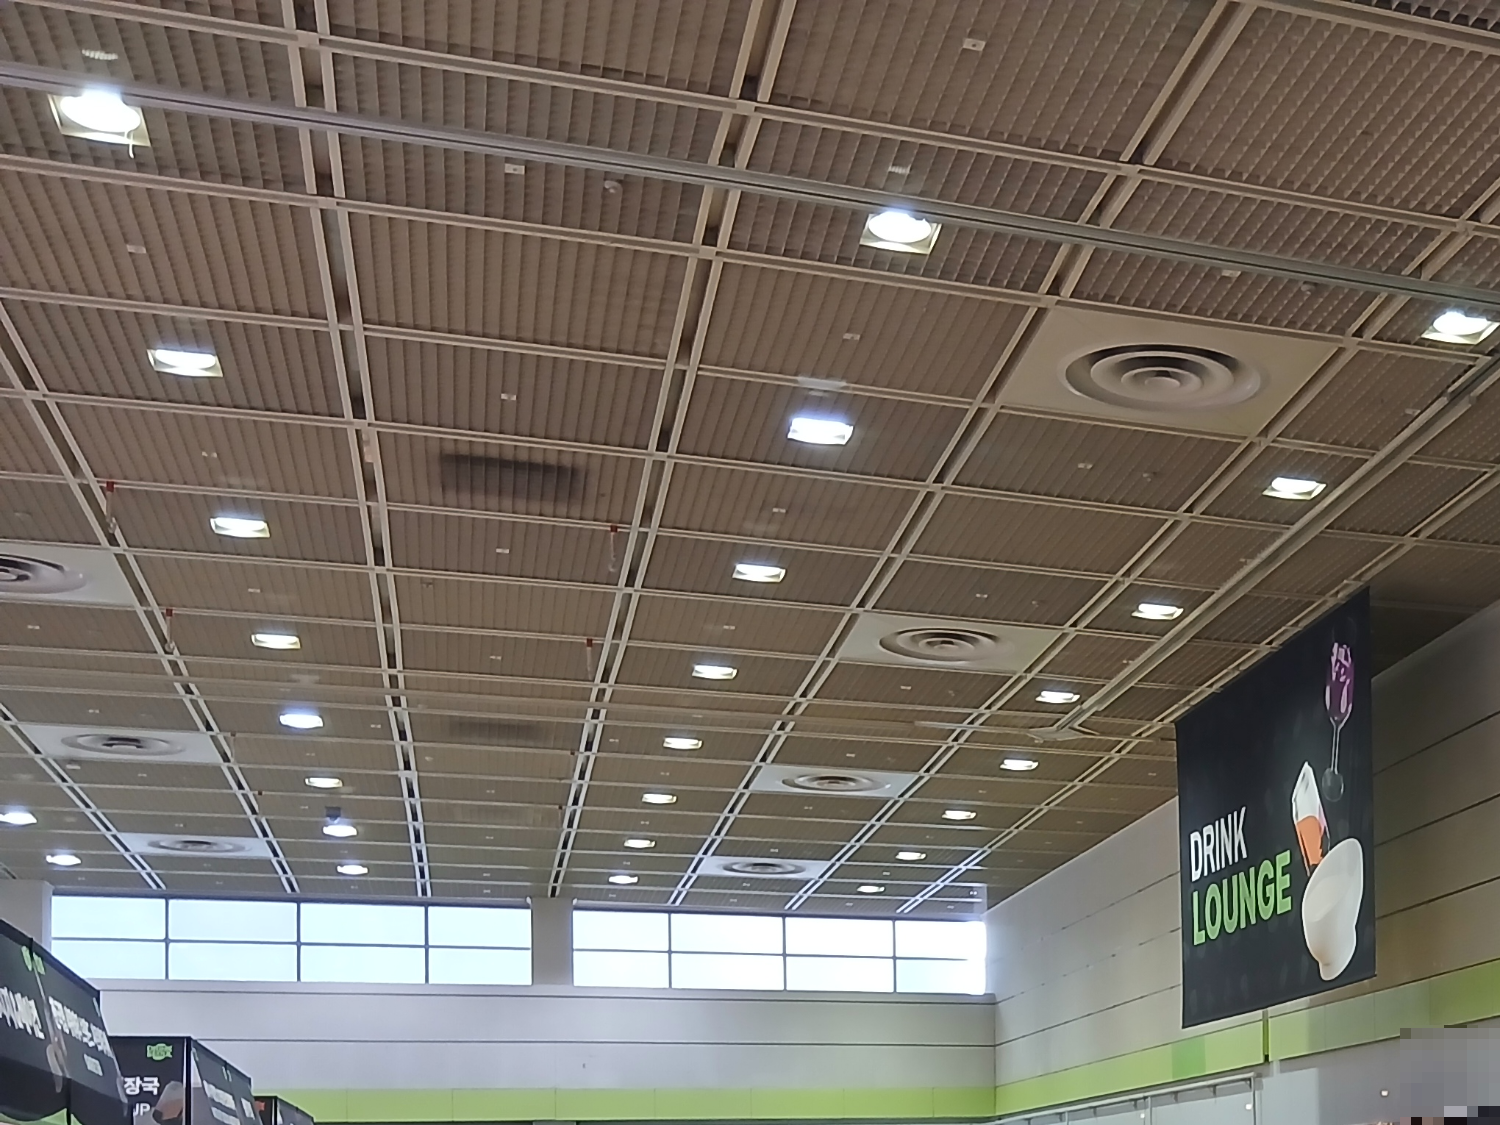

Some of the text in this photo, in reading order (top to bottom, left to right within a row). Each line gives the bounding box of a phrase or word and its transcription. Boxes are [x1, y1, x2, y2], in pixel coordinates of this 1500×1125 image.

[1190, 806, 1248, 882] DRINK
[1192, 849, 1293, 946] LOUNGE
[123, 1075, 161, 1096] 장국
